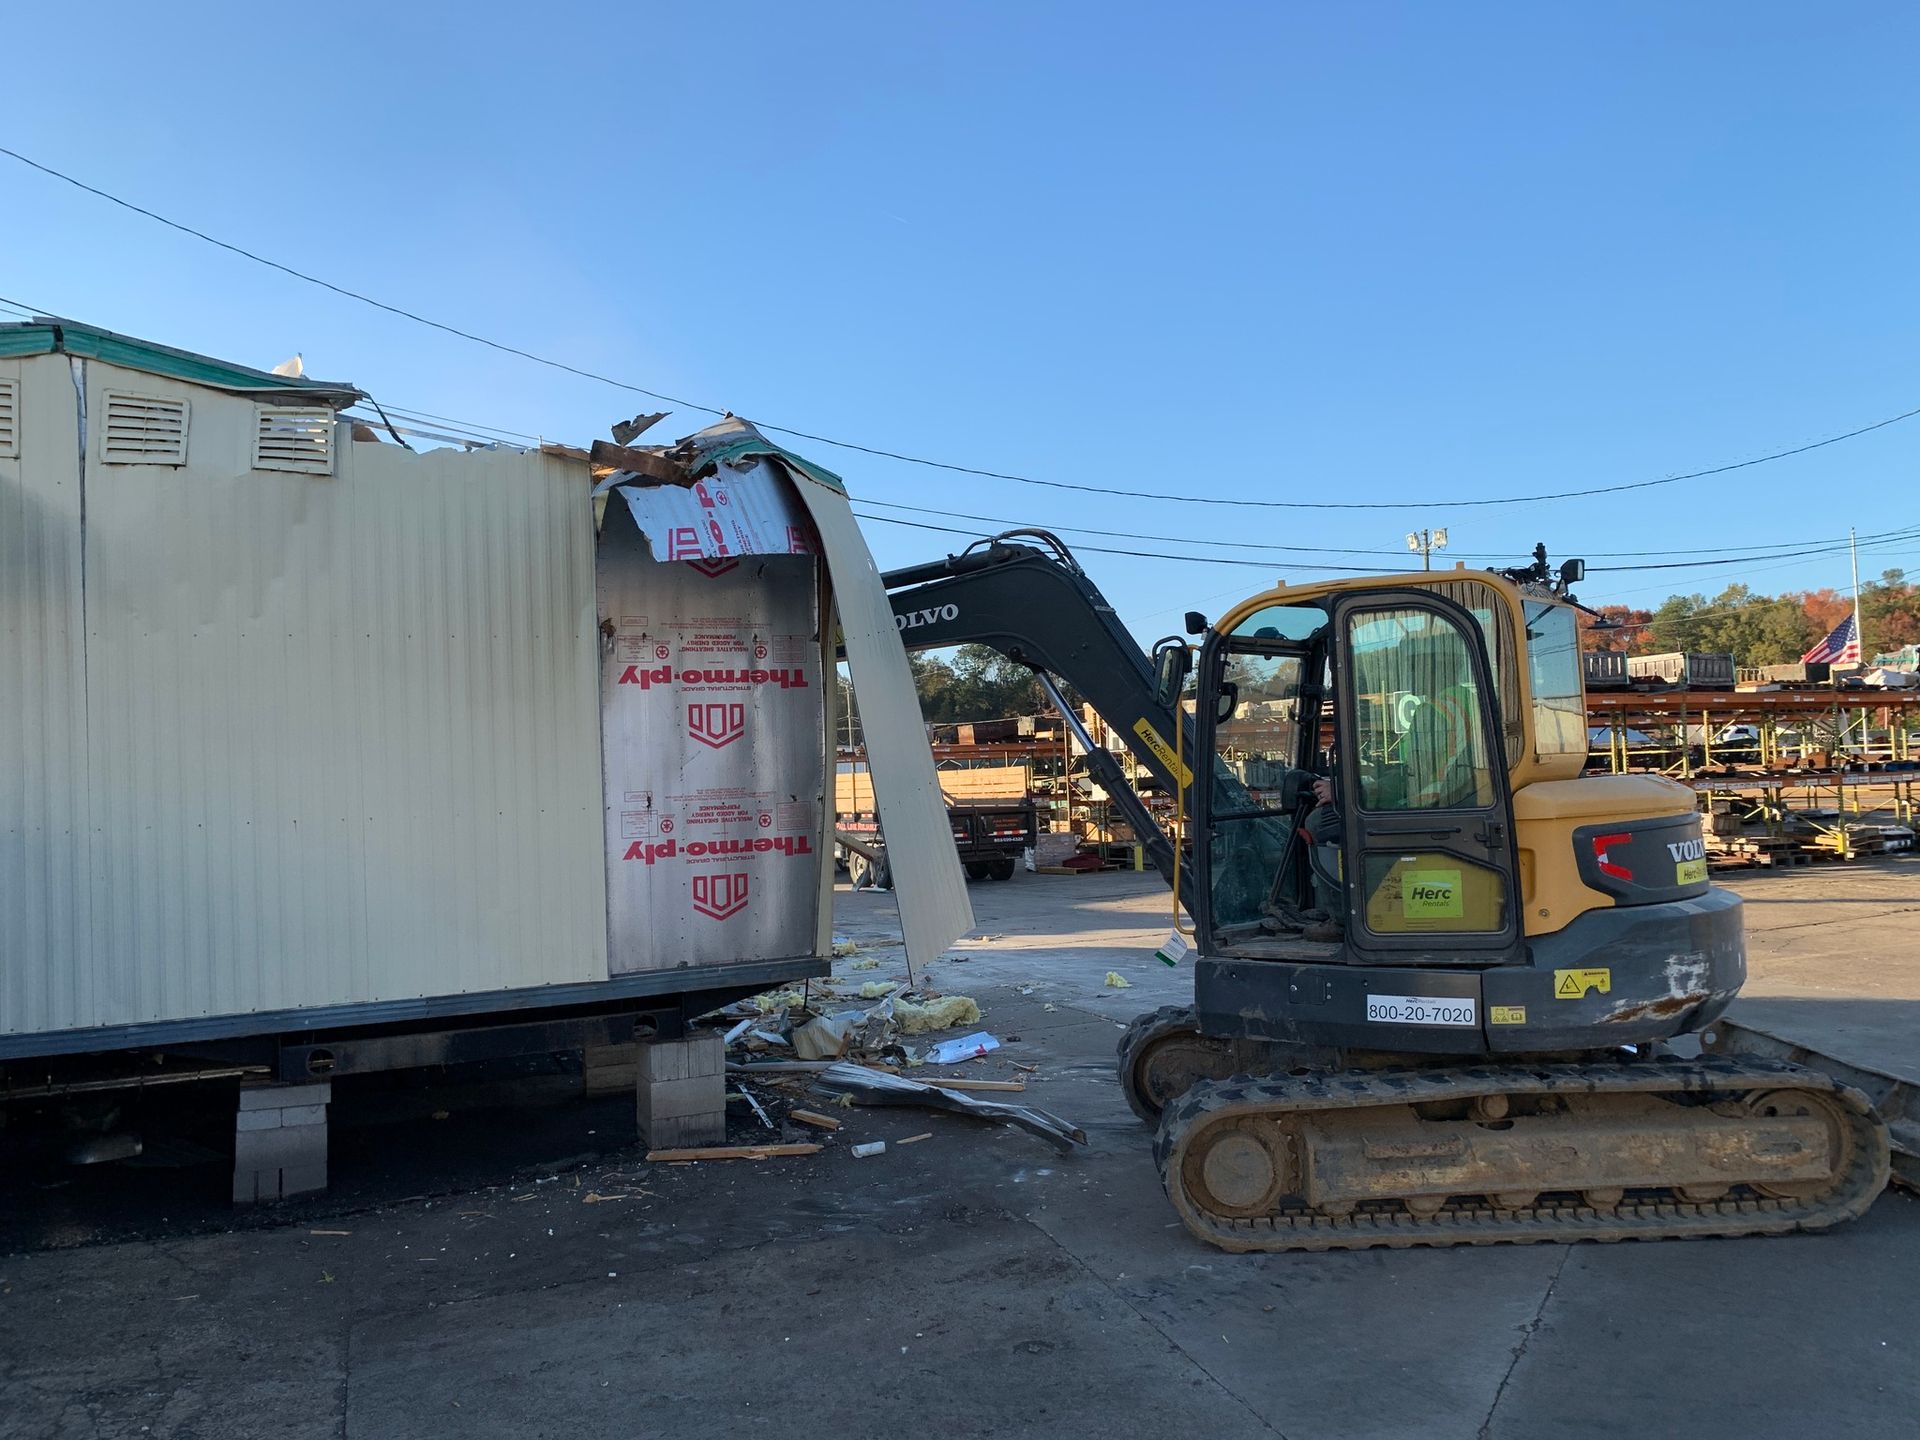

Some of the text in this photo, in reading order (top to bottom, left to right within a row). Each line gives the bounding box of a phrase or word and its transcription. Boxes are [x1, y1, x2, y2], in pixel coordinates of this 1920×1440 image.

[894, 603, 959, 631] OLVO
[685, 816, 719, 824] SHEATHING
[685, 854, 756, 864] STRUCTURAL GRADE
[1411, 887, 1453, 900] Herc
[1368, 1004, 1474, 1023] 800-20-7020
